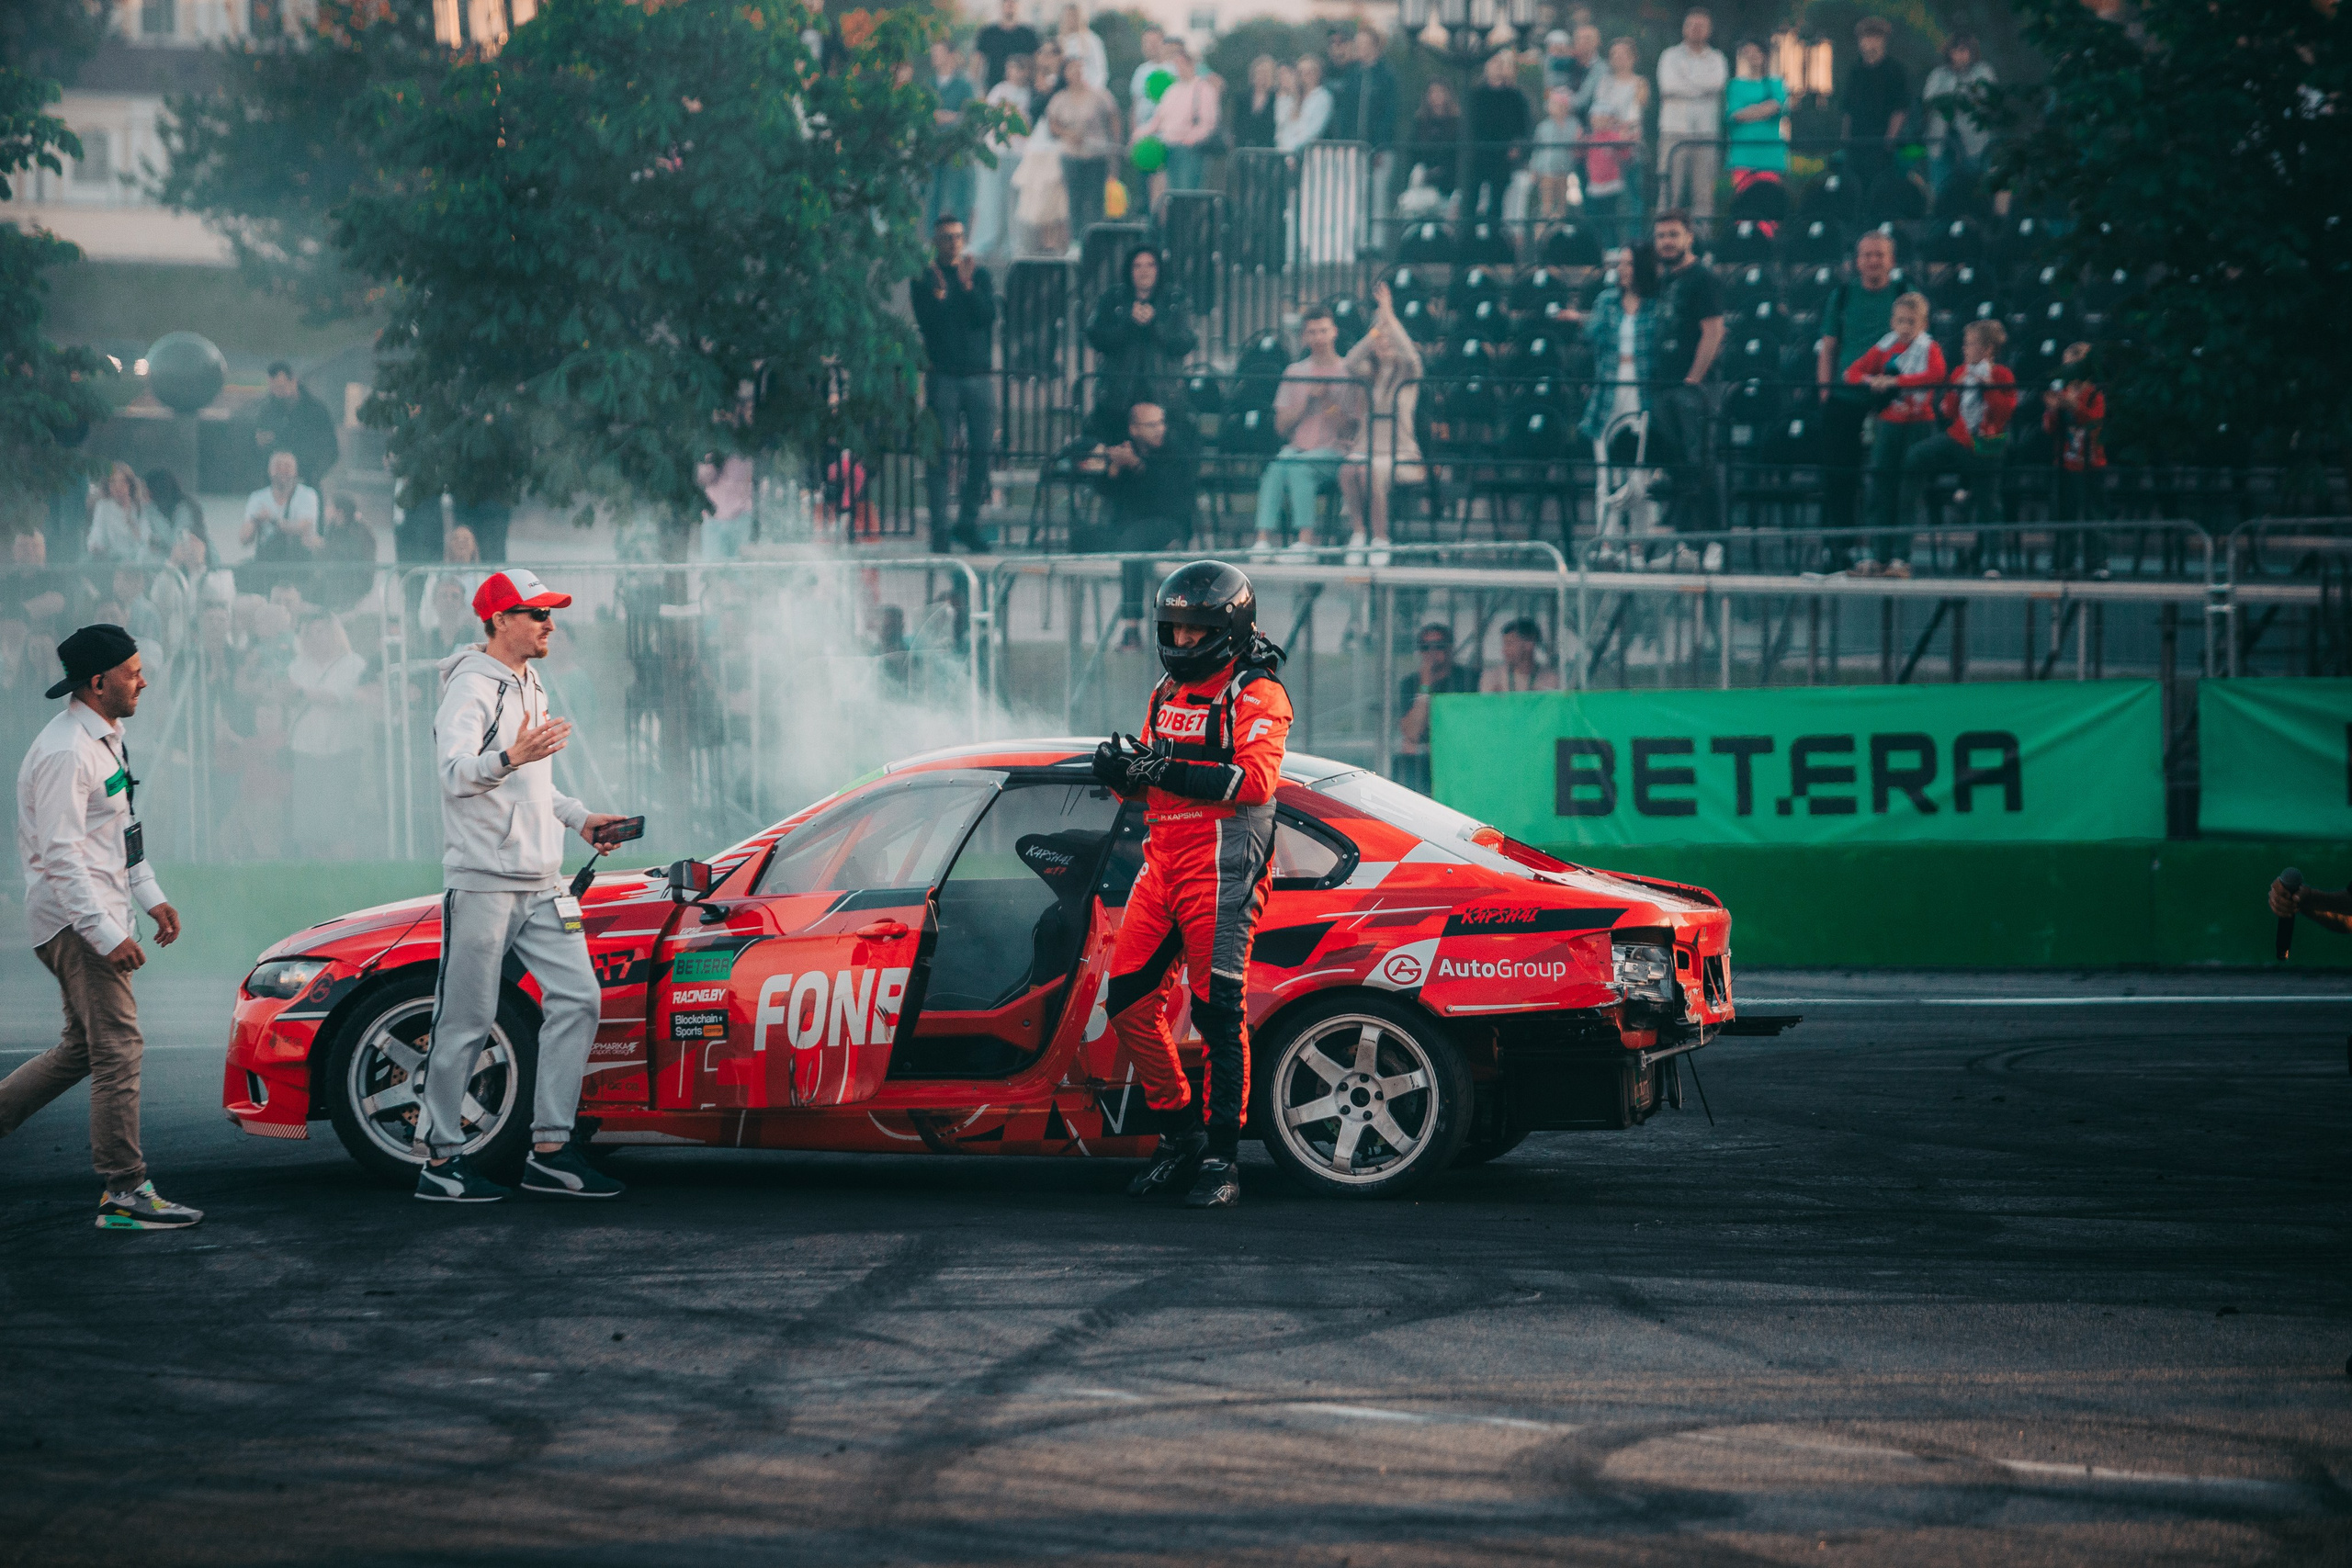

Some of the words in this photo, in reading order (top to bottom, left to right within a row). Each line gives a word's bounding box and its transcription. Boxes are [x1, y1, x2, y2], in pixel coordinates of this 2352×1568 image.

[1025, 844, 1075, 865] KAPSHAI
[1461, 907, 1542, 924] KAPSHAI
[1438, 958, 1566, 981] AutoGroup
[674, 1013, 718, 1025] Blockchain
[675, 1026, 703, 1038] Sports
